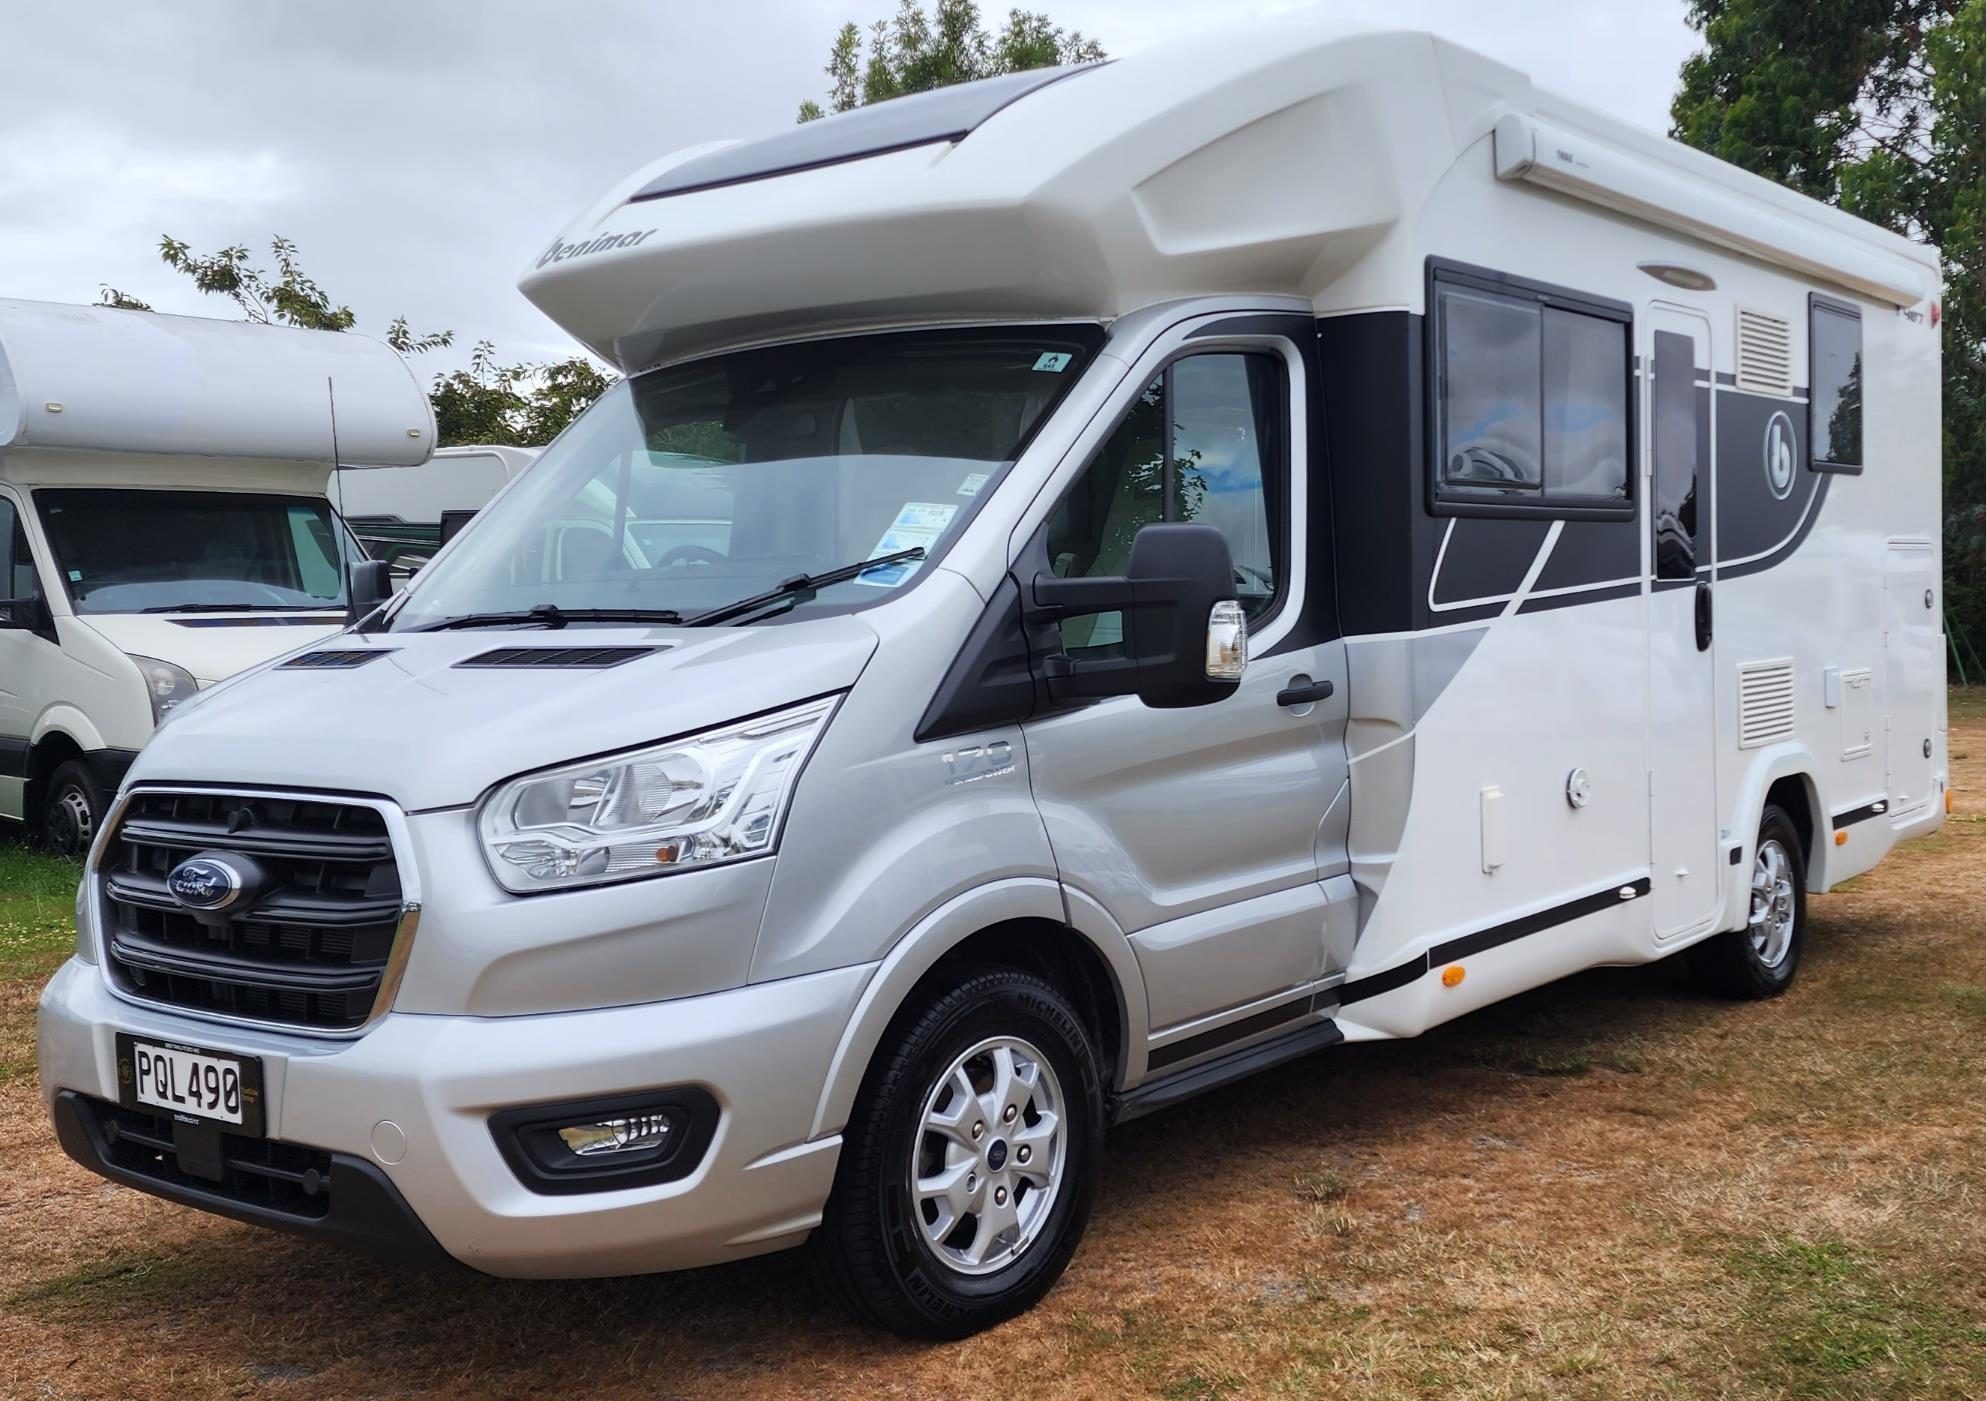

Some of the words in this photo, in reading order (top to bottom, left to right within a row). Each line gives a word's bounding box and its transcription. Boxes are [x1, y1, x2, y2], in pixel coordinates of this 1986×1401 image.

[535, 228, 659, 270] benimar
[175, 866, 218, 898] Ford
[1017, 992, 1086, 1050] MICHELIN
[137, 1050, 240, 1115] PQL490
